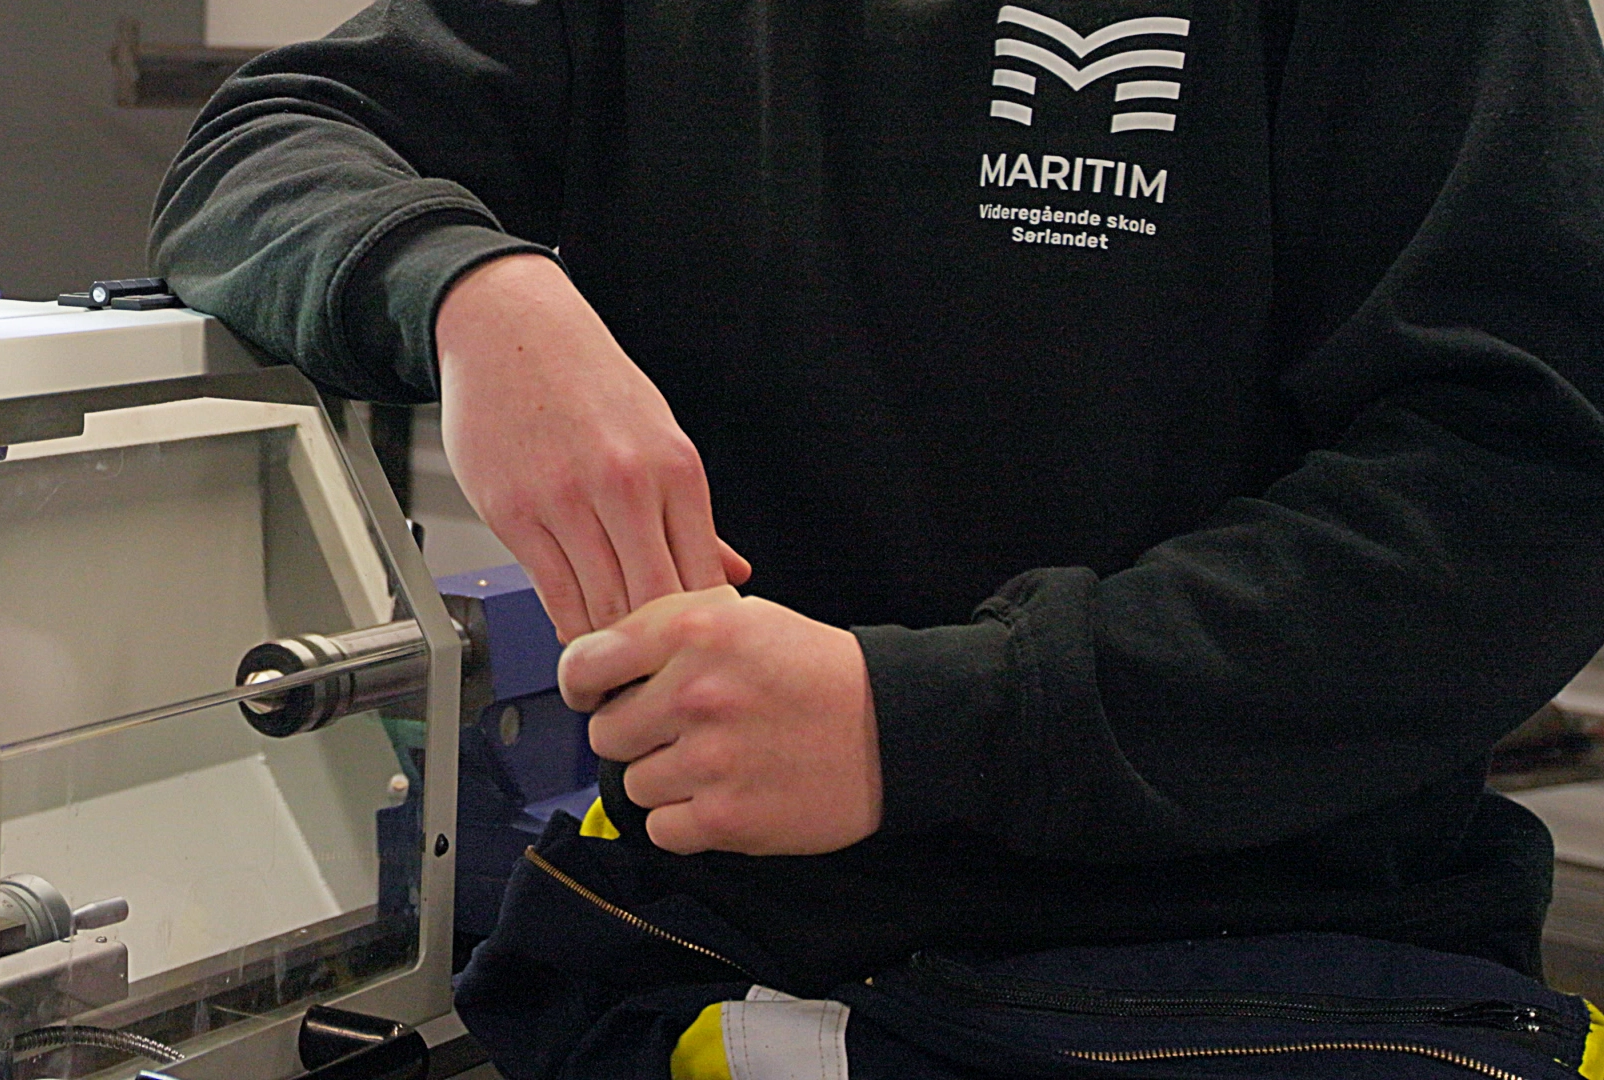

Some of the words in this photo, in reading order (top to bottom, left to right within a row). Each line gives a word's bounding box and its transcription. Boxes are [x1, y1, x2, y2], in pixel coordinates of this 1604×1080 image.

[979, 153, 1168, 203] MARITIM
[979, 203, 1101, 225] Videregående
[1106, 214, 1157, 235] skole
